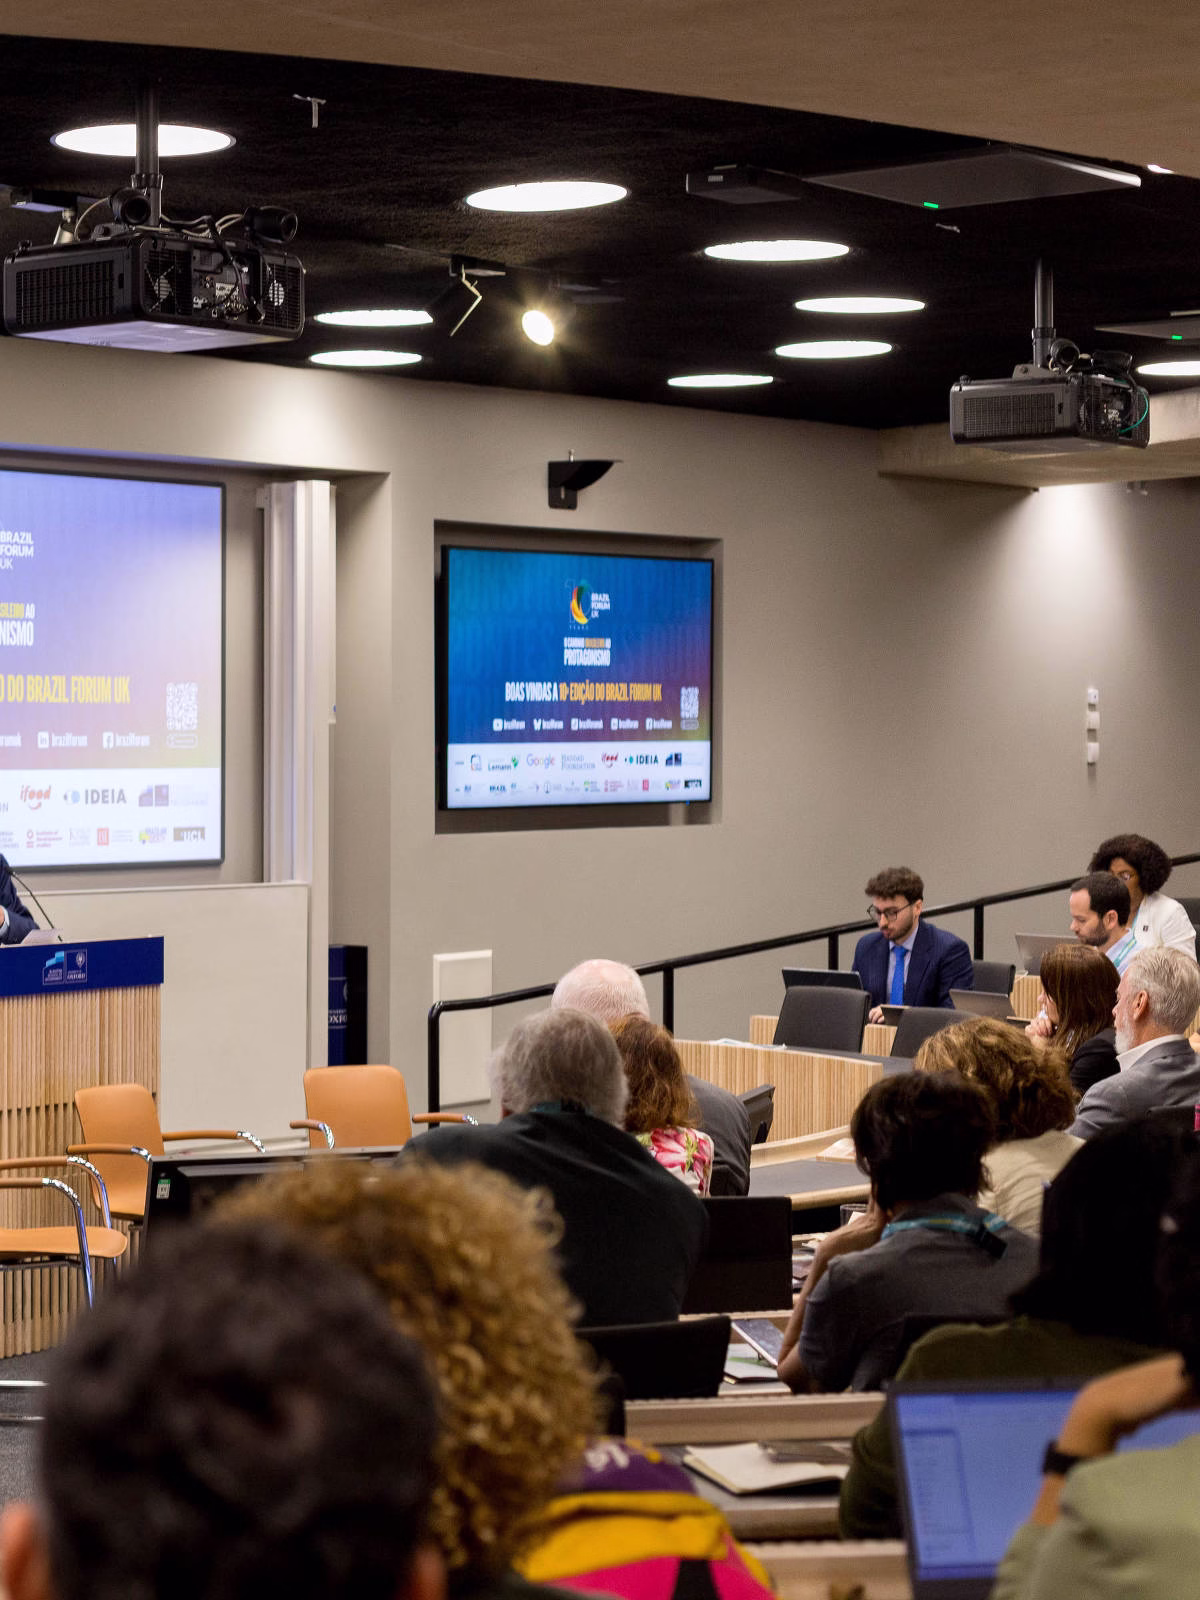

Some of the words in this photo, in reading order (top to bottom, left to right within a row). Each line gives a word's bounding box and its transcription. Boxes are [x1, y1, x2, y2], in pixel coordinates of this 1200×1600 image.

[0, 531, 34, 544] BRAZIL
[0, 544, 34, 557] FORUM
[0, 558, 13, 570] UK
[7, 674, 24, 702] DO
[26, 674, 69, 703] BRAZIL
[71, 676, 112, 704] FORUM
[114, 676, 131, 704] UK
[505, 682, 525, 701] BOAS
[525, 682, 552, 701] VINDAS
[552, 682, 558, 701] A
[595, 683, 605, 701] DO
[606, 683, 629, 701] BRAZIL
[630, 683, 652, 701] FORUM
[653, 683, 662, 701] UK
[636, 754, 659, 765] IDEIA
[84, 789, 127, 804] IDEIA
